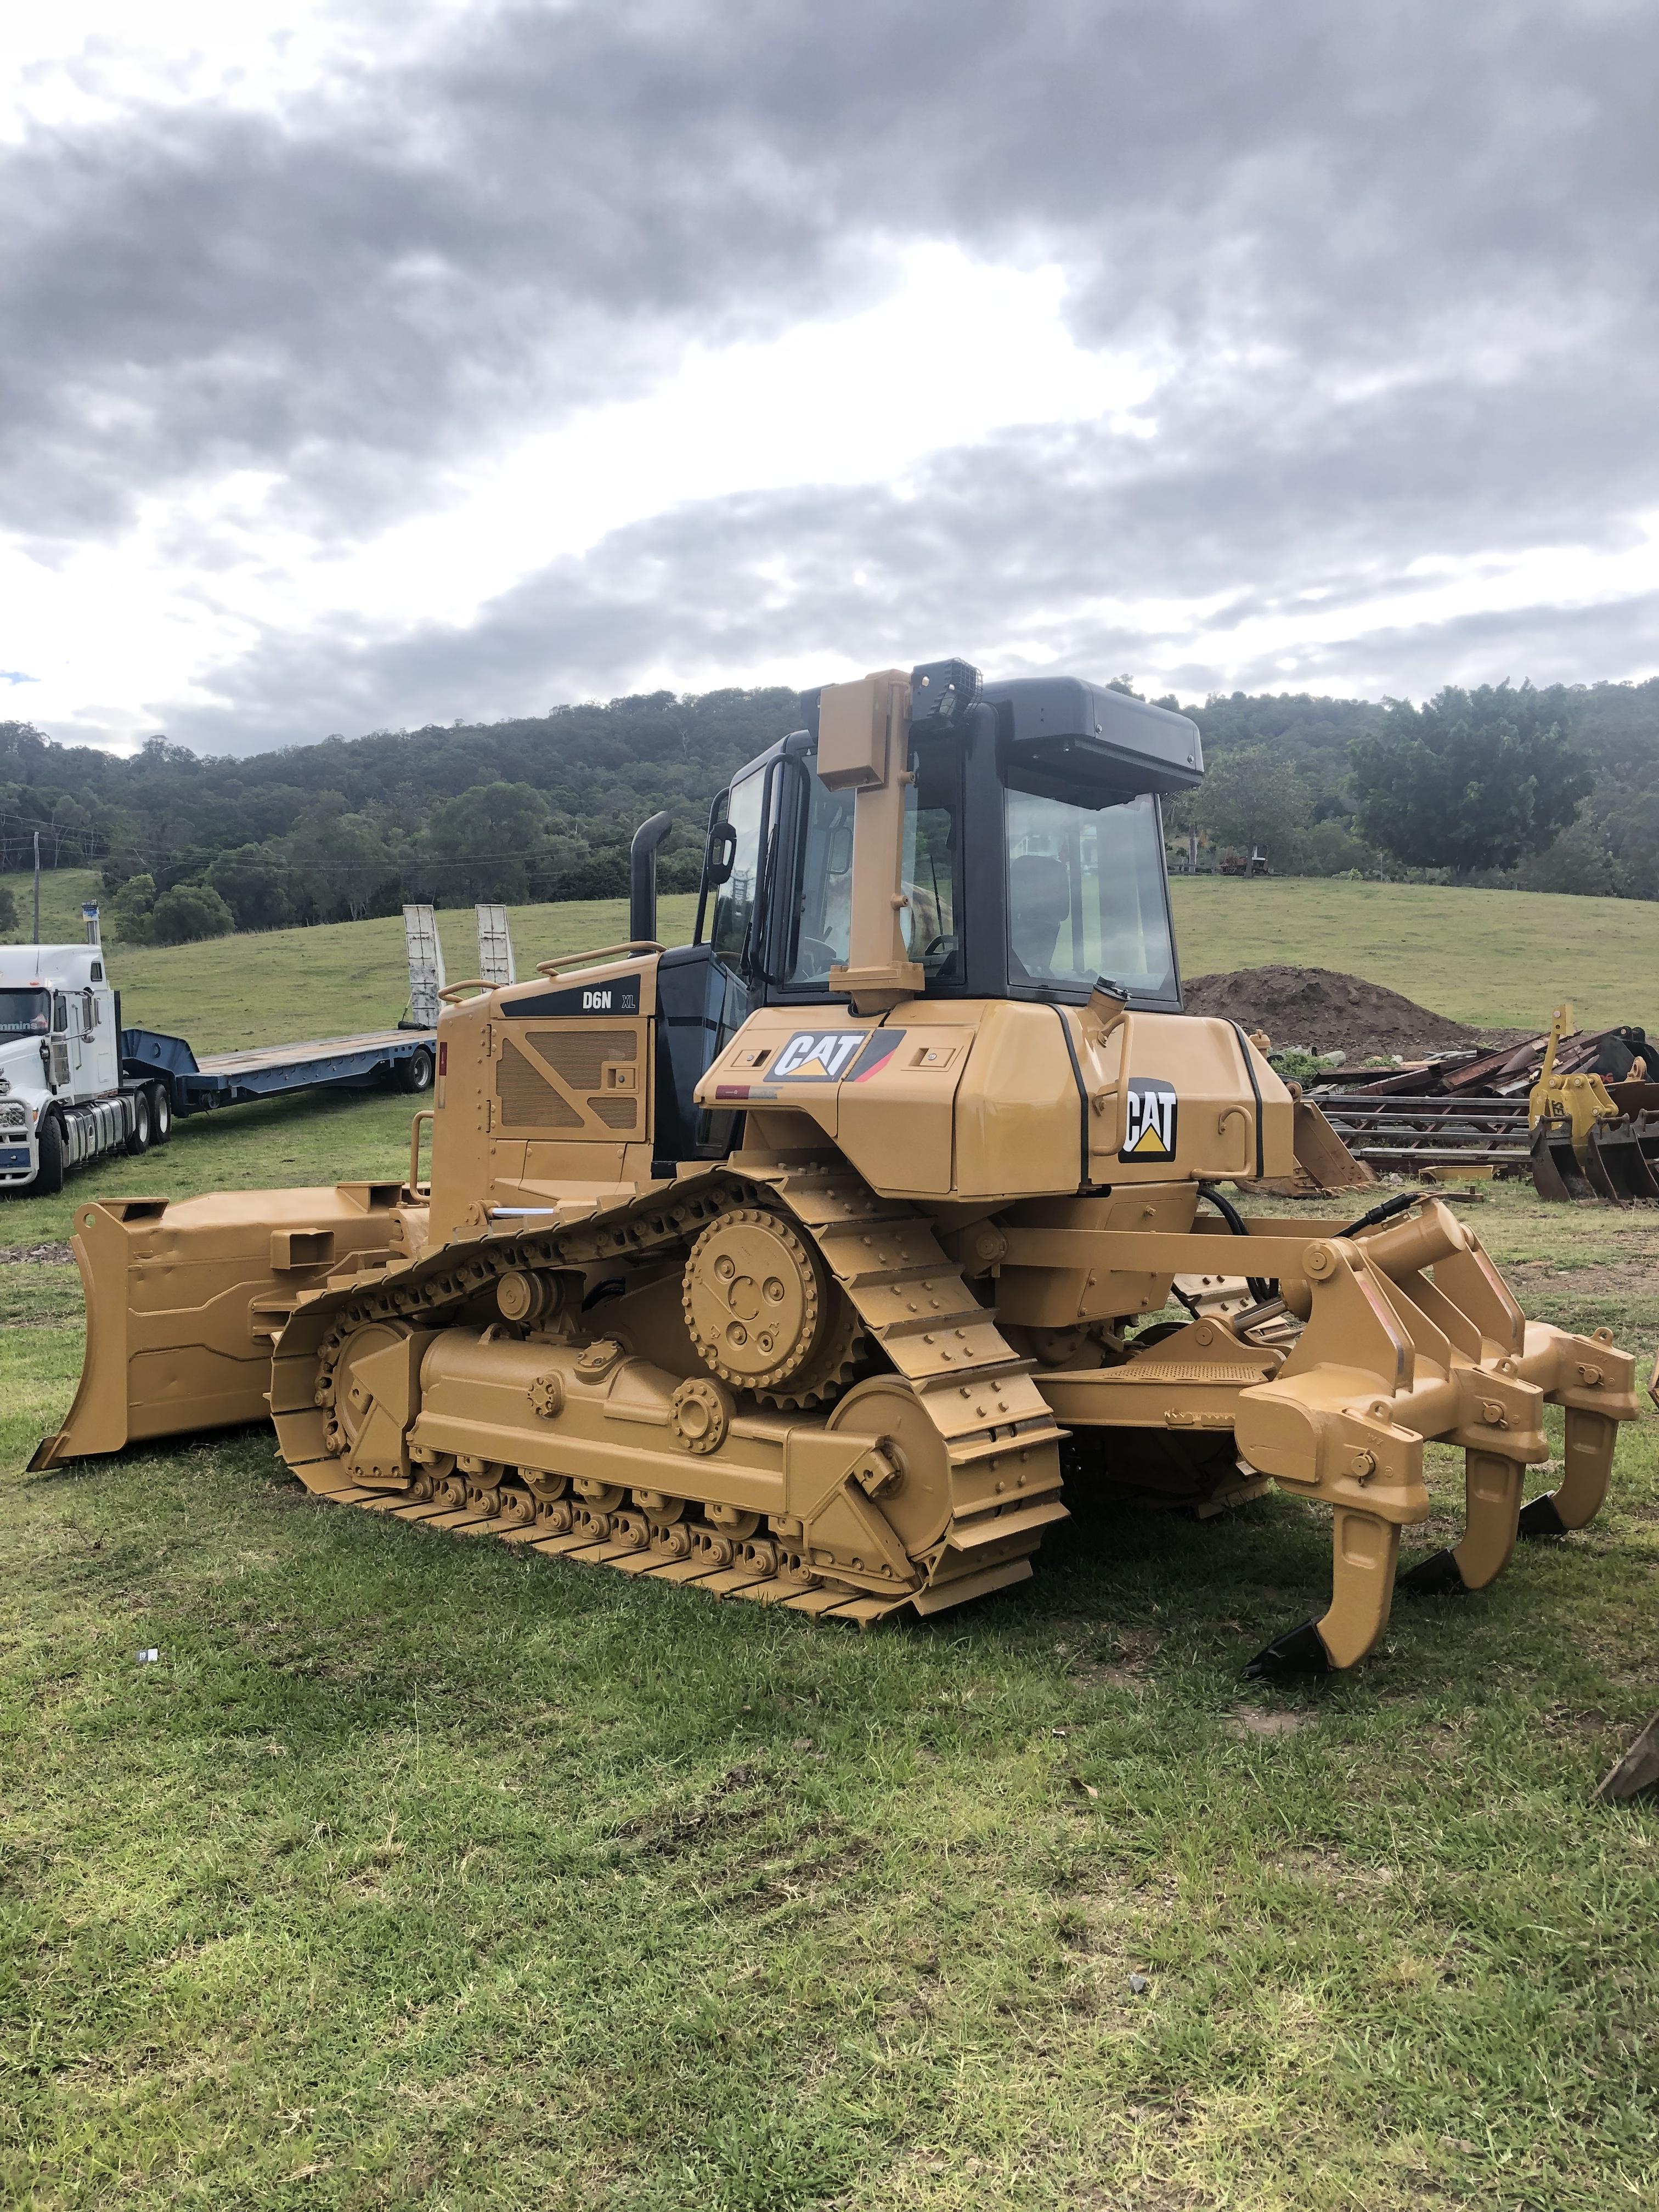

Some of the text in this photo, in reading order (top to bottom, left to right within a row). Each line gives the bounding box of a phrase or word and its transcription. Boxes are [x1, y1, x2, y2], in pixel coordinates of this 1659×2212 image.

[583, 991, 636, 1009] D6N XL
[774, 1035, 865, 1076] CAT
[1122, 1091, 1177, 1152] CAT
